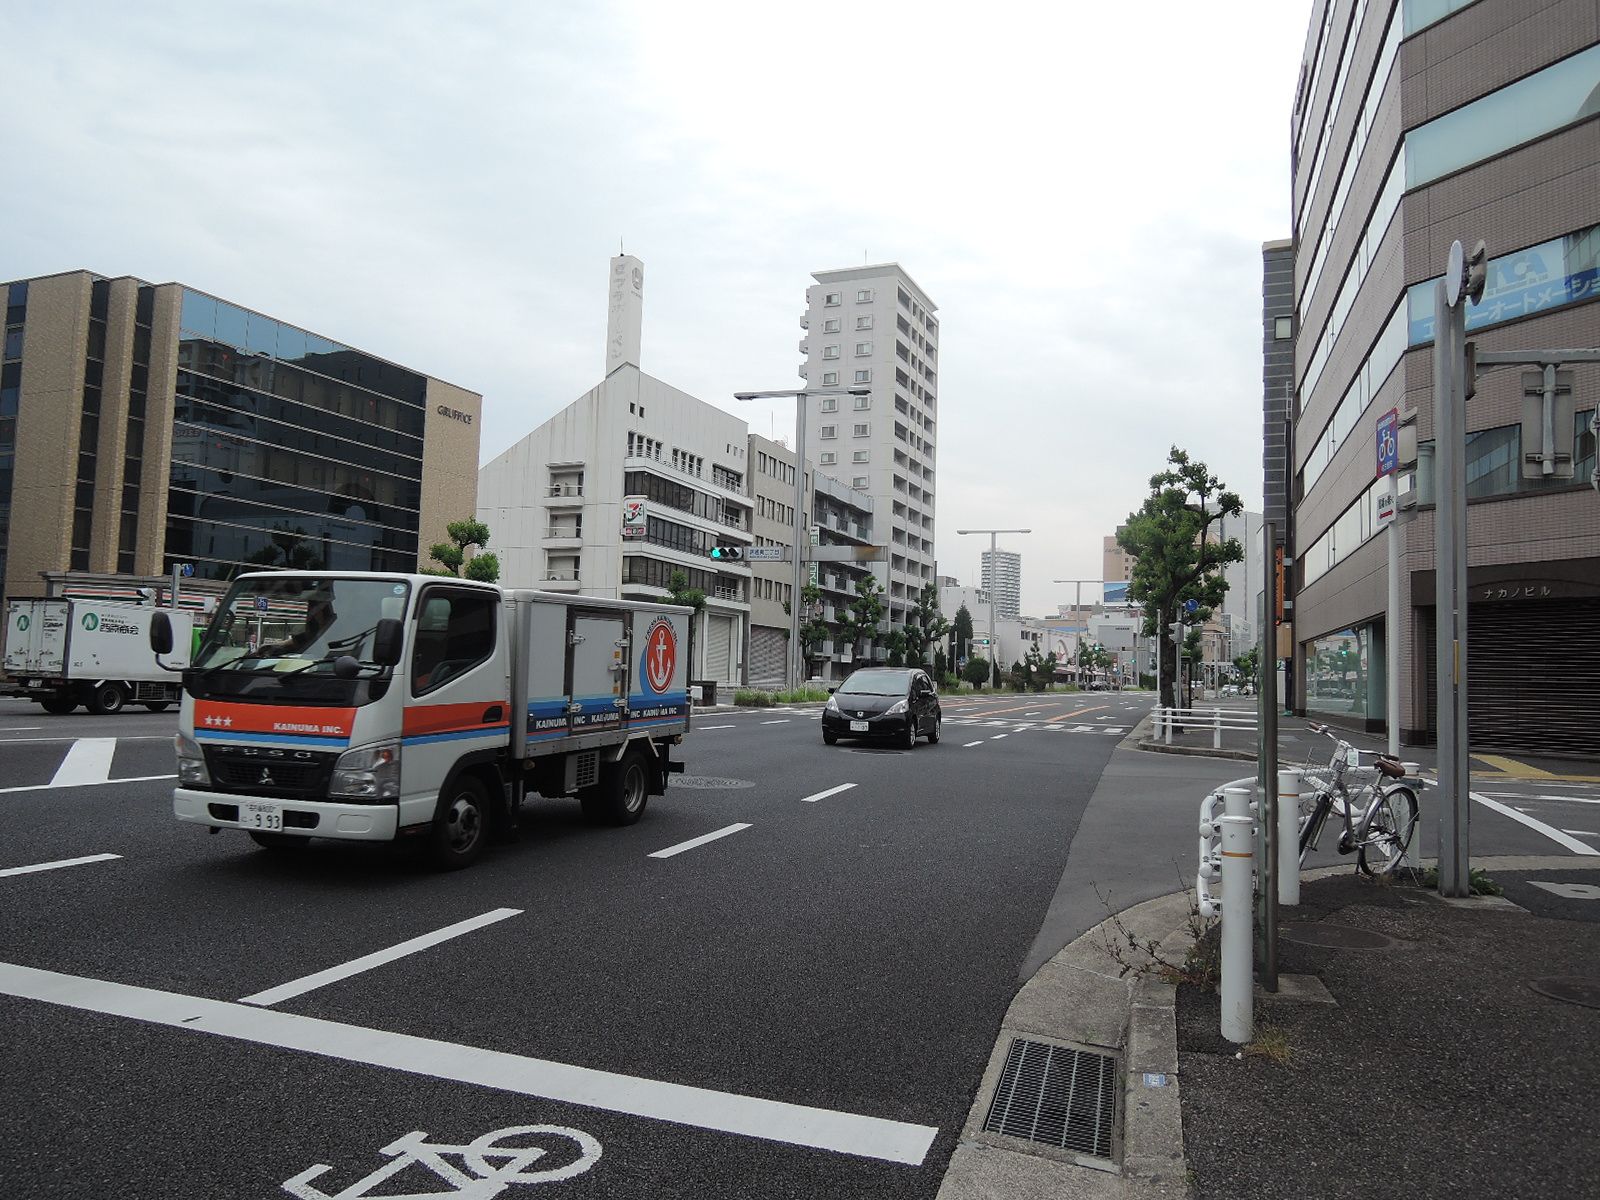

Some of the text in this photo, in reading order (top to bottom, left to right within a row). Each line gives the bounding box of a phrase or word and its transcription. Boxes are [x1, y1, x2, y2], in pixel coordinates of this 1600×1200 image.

[1484, 586, 1551, 598] ナカノビル
[534, 718, 567, 729] KAINUMA
[574, 716, 586, 725] INC
[630, 710, 640, 719] INC
[273, 722, 344, 734] KAINUMA INC.
[220, 746, 312, 759] FUSO
